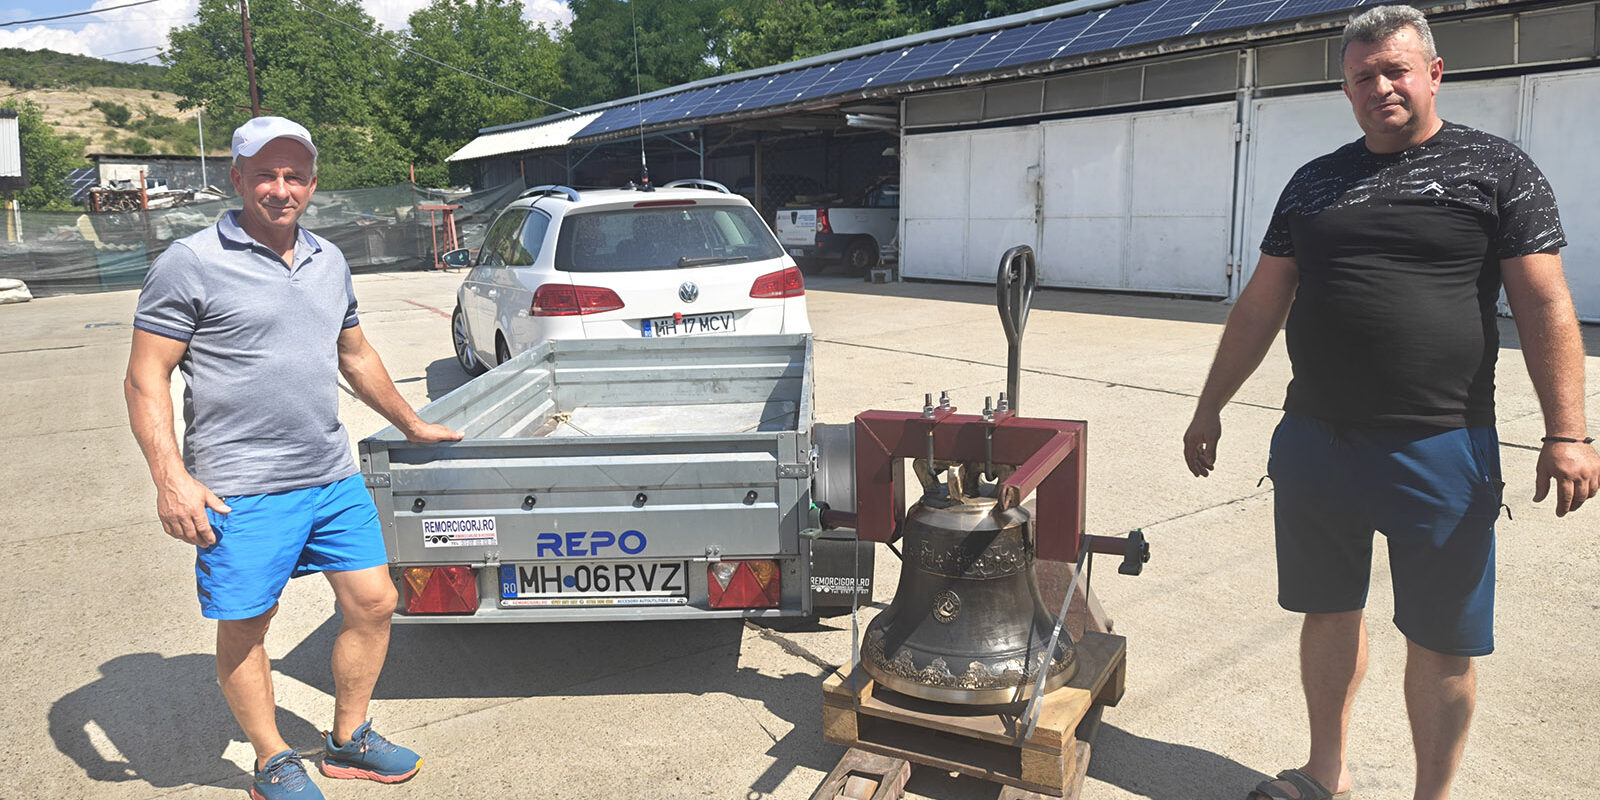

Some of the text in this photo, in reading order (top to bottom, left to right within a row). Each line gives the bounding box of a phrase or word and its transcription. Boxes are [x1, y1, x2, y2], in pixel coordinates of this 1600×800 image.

[682, 318, 696, 333] 17
[700, 315, 730, 332] MCV
[424, 518, 494, 533] REMORCIGORJ.RO
[536, 530, 647, 557] REPO
[503, 582, 517, 594] RO
